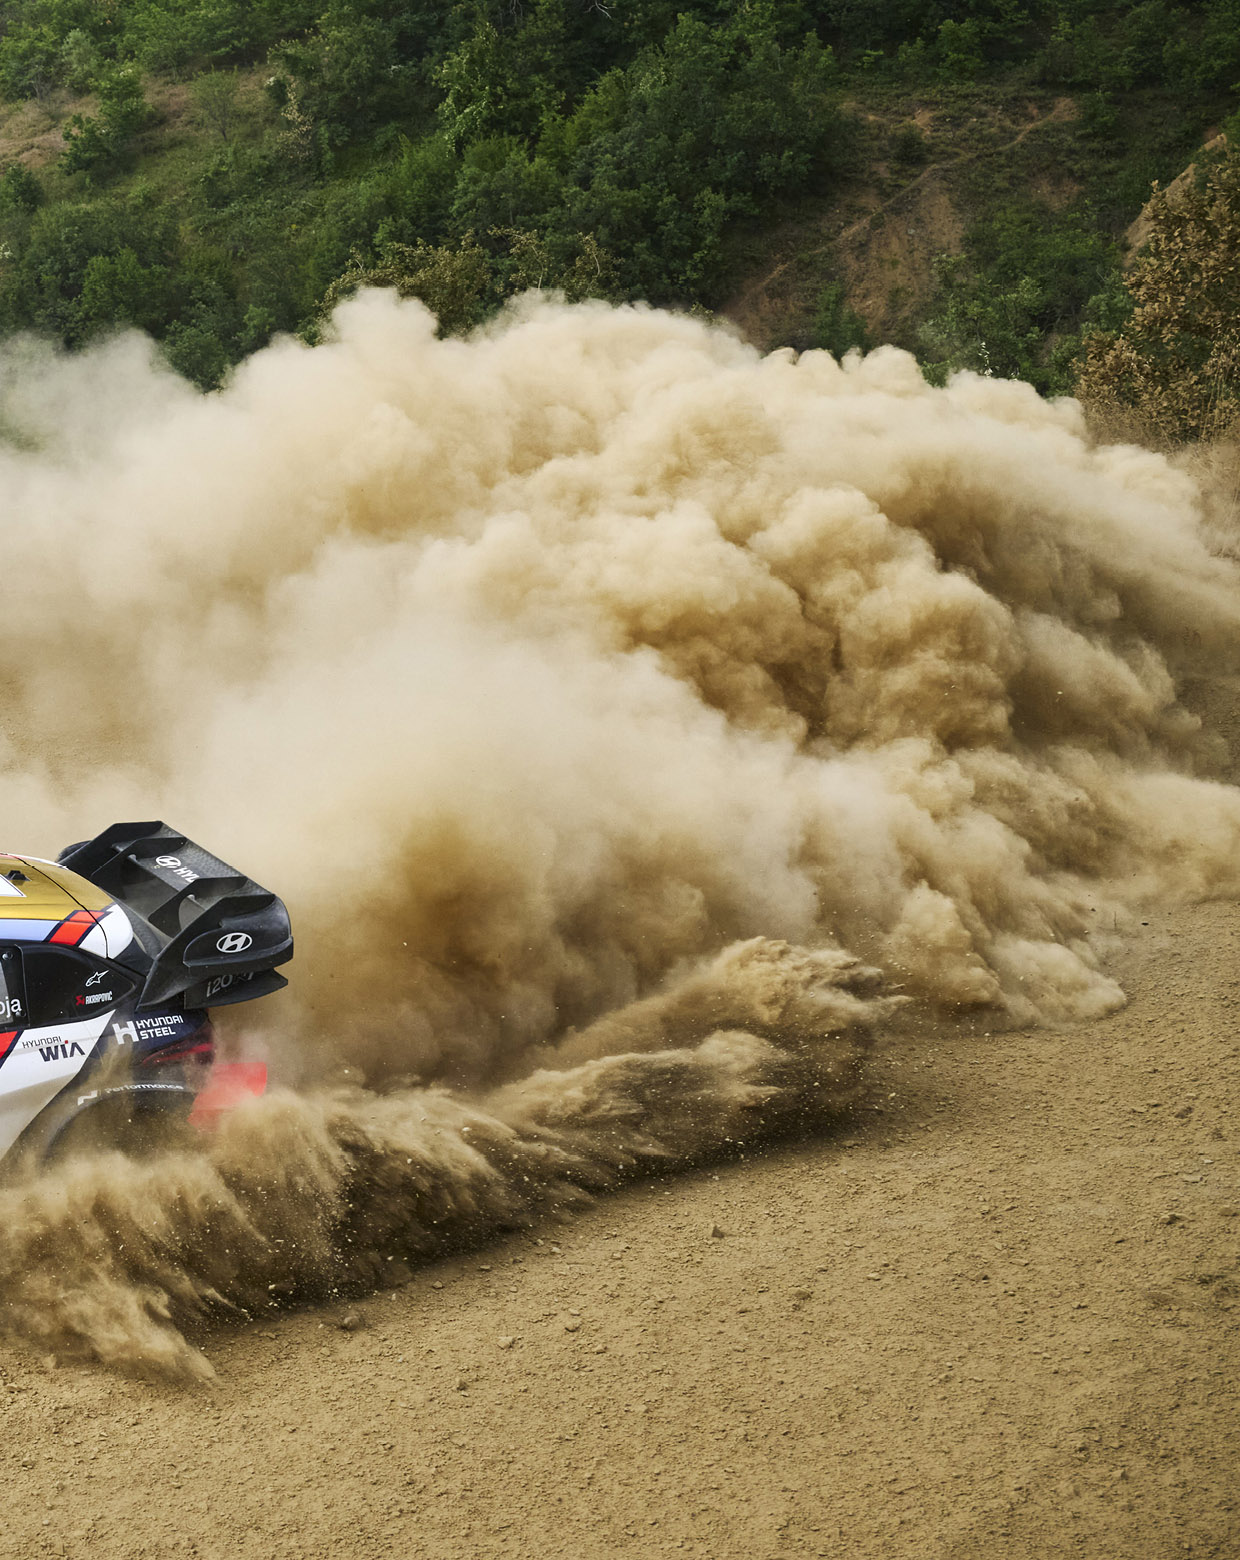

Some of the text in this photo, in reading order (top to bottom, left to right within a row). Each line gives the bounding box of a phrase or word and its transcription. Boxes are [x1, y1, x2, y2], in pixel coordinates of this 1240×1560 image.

[136, 1014, 184, 1029] HYUNDAI
[140, 1026, 176, 1040] STEEL
[22, 1036, 62, 1049] HYUNDAI
